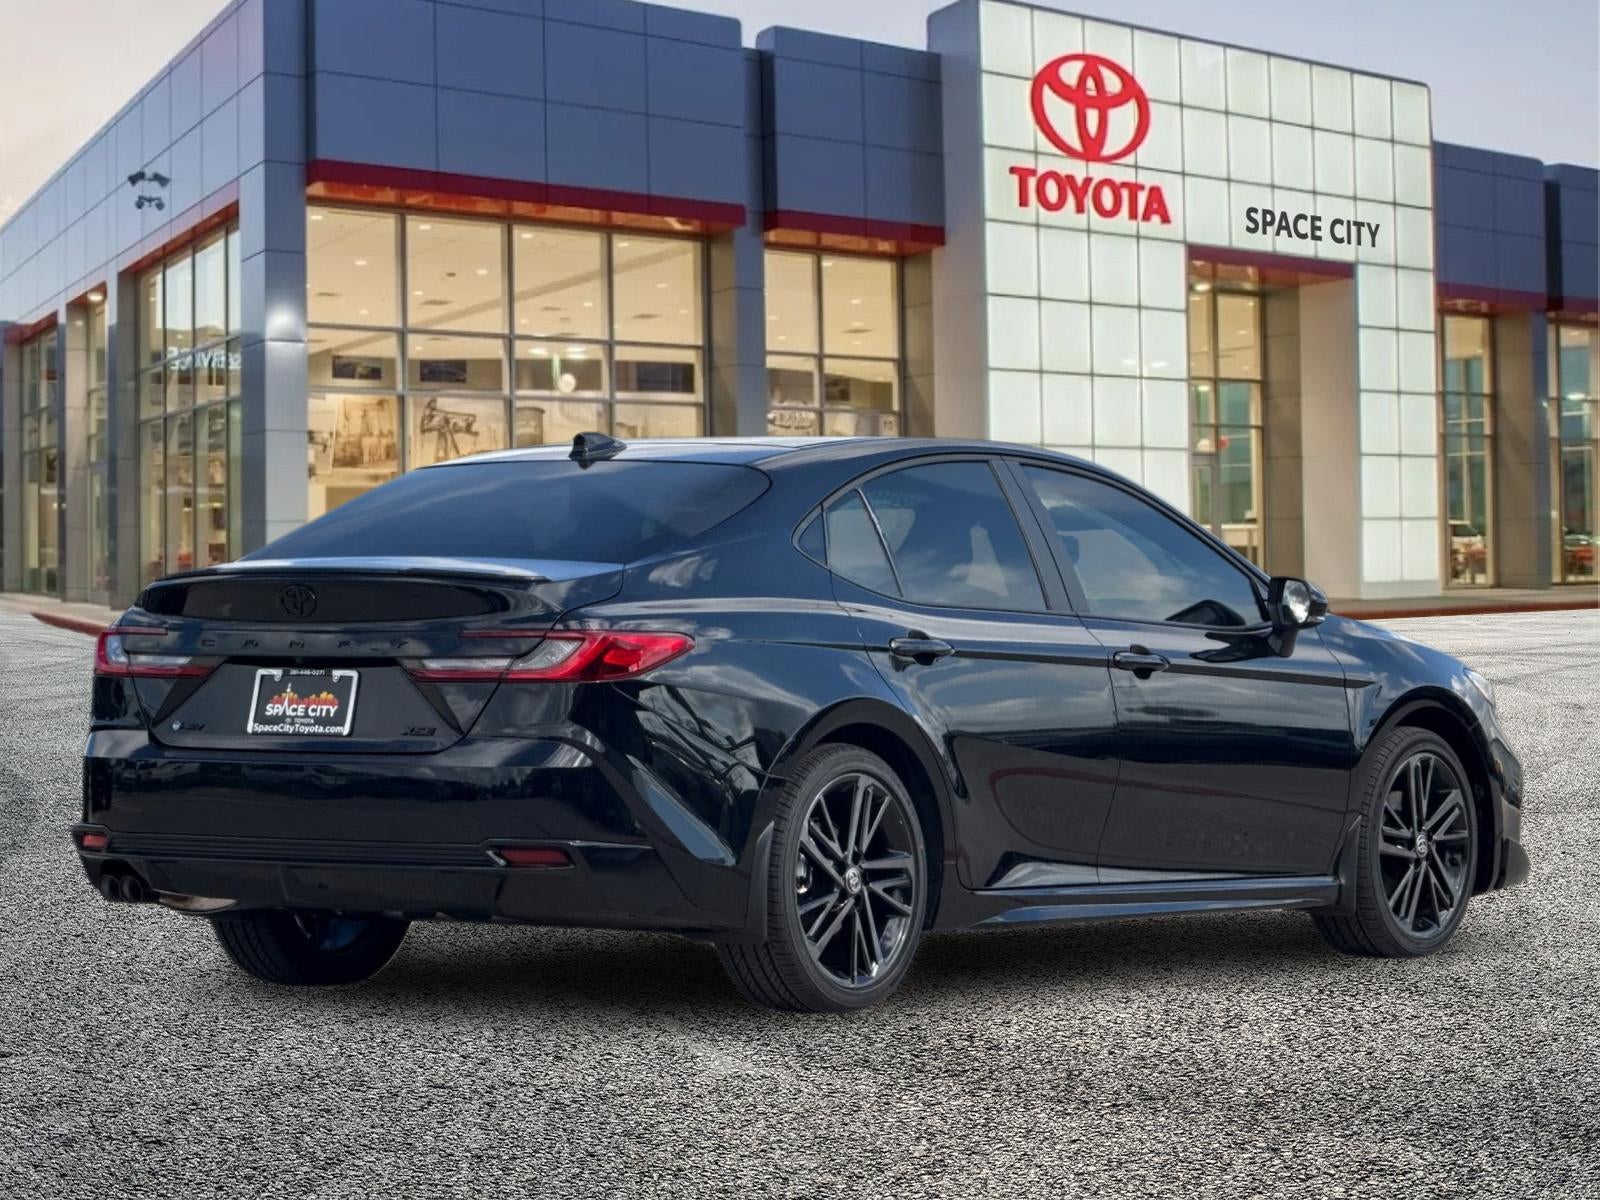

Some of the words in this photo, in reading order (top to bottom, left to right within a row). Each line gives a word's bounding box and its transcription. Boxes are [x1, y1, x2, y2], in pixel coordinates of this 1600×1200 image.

[1008, 166, 1172, 225] TOYOTA
[1245, 206, 1323, 242] SPACE
[1329, 218, 1381, 248] CITY
[265, 698, 305, 716] SPACE
[307, 704, 339, 717] CITY
[253, 722, 345, 734] SpaceCityToyota.com
